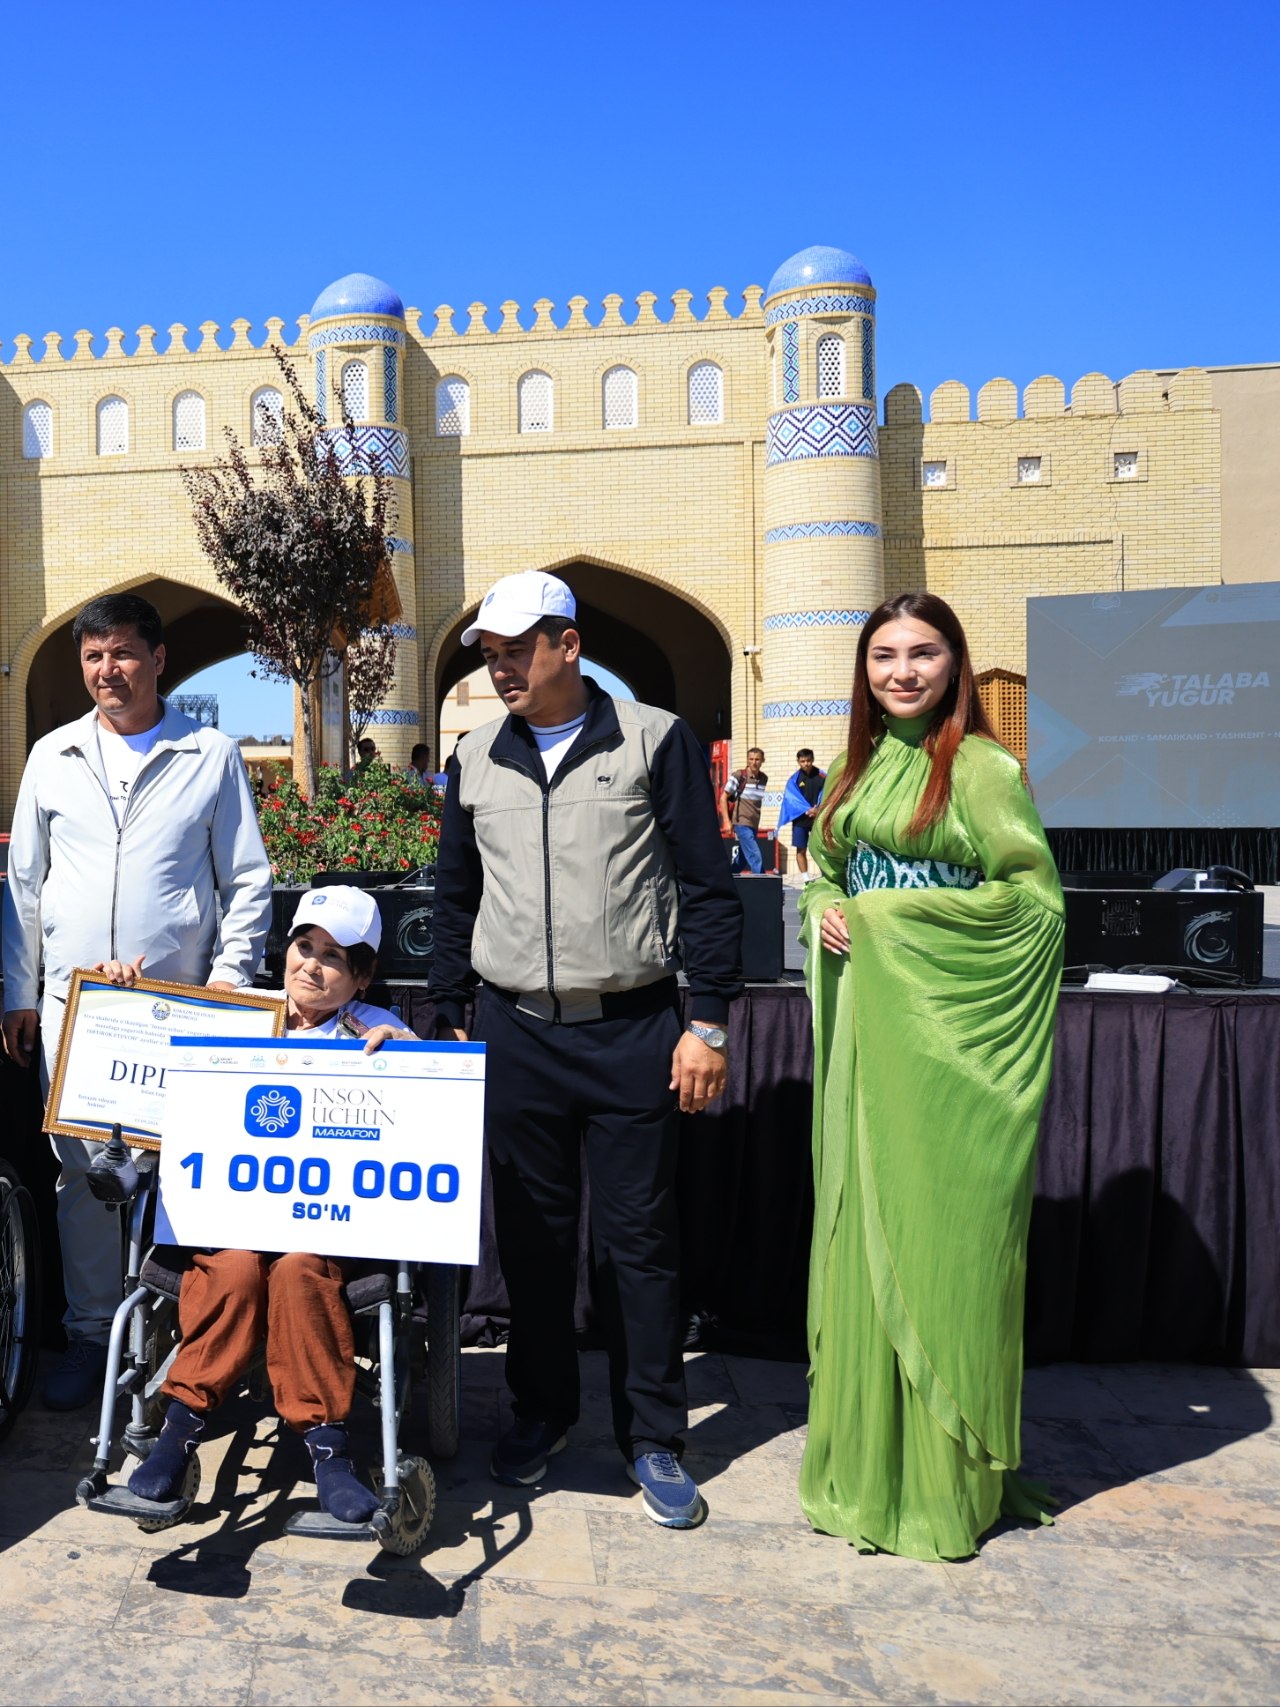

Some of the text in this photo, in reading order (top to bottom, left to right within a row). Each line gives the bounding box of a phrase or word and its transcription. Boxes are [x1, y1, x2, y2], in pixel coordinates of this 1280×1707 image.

[1170, 672, 1271, 690] TALABA
[1146, 688, 1236, 708] YUGUR
[1098, 735, 1138, 743] KOKAND
[1146, 732, 1208, 742] SAMARKAND
[1216, 731, 1265, 740] TASHKENT
[313, 1088, 383, 1106] INSON
[313, 1107, 396, 1126] UCHUN
[314, 1128, 379, 1140] MARAFON
[180, 1153, 460, 1203] 1 000 000
